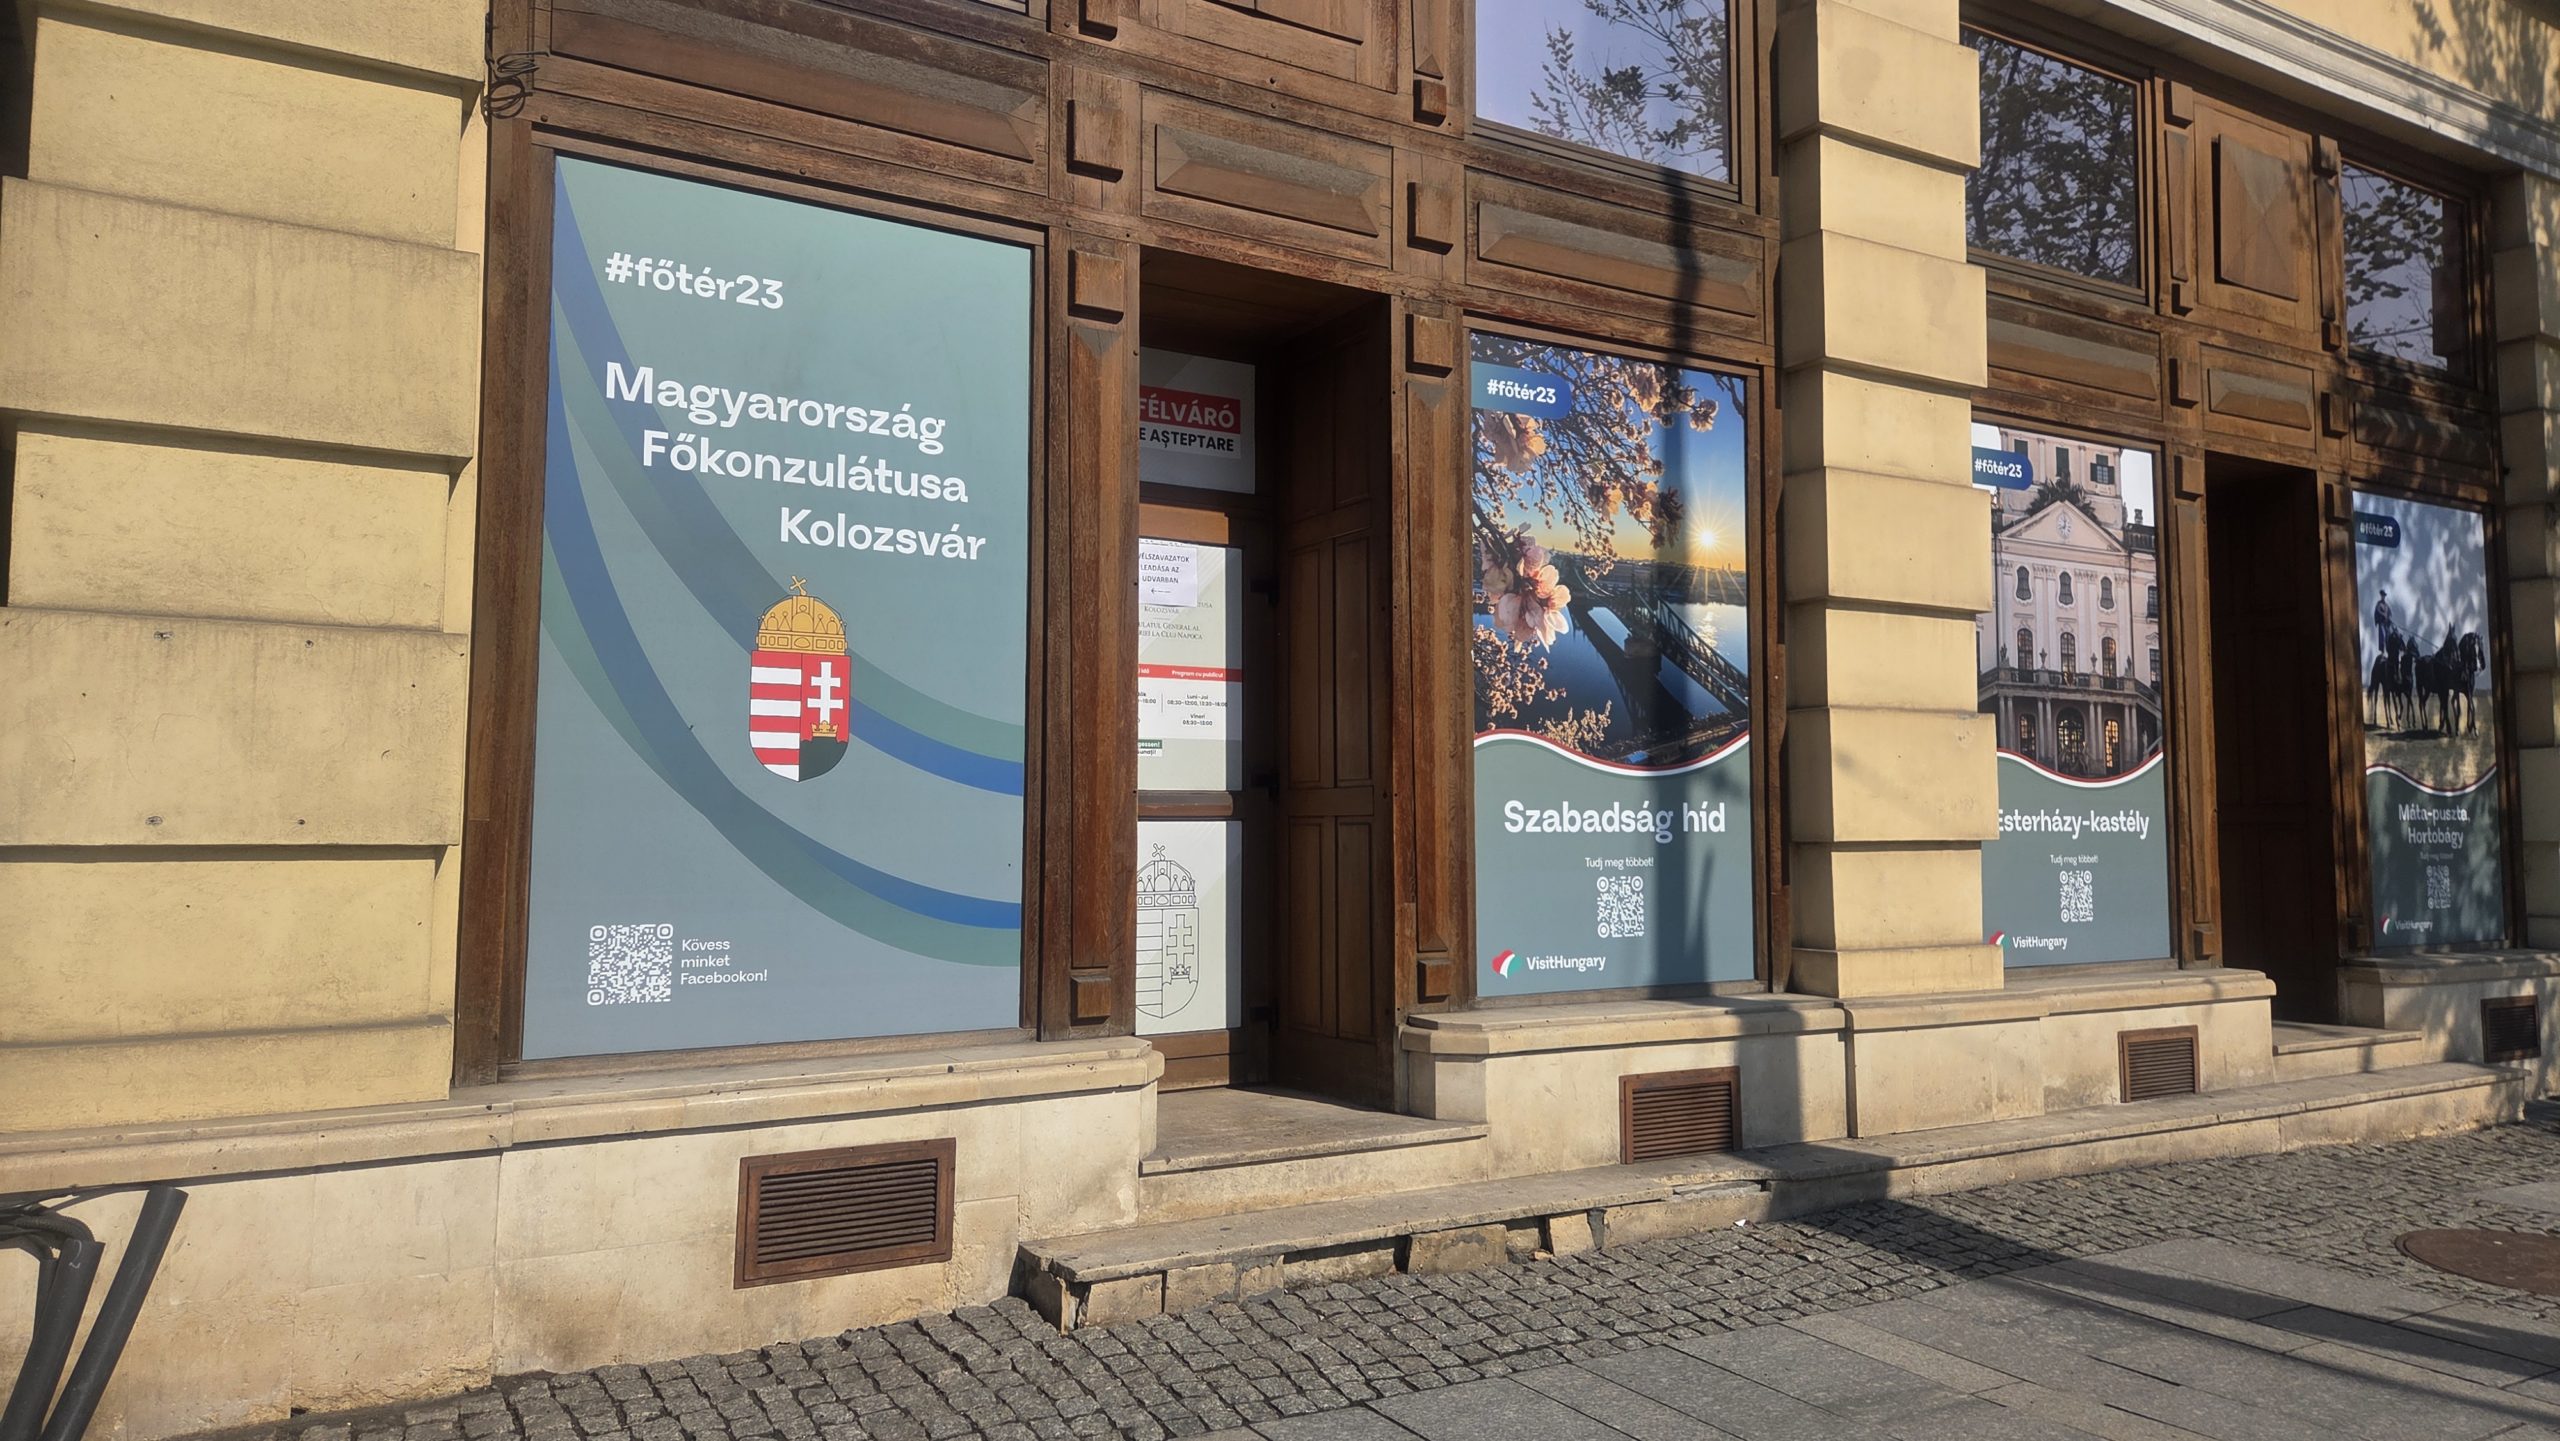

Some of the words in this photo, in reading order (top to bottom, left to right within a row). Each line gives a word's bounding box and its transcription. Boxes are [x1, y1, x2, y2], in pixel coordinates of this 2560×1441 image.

[605, 252, 784, 309] #főtér23
[1487, 379, 1556, 404] #főtér23
[605, 361, 946, 455] Magyarország
[643, 430, 968, 503] Főkonzulátusa
[1974, 458, 2023, 478] #főtér23
[780, 507, 986, 560] Kolozsvár
[1142, 575, 1179, 583] UDVARBAN
[1504, 800, 1673, 844] Szabadság
[1683, 801, 1726, 832] híd
[2408, 827, 2464, 849] Hortobágy
[1585, 857, 1603, 870] Tudj
[1605, 860, 1624, 870] meg
[1625, 857, 1654, 868] többet!
[2050, 855, 2063, 866] Tudj
[2064, 857, 2077, 866] meg
[682, 938, 730, 951] Kövess
[2012, 936, 2068, 950] VisitHungary
[681, 954, 730, 968] minket
[1526, 955, 1606, 972] VisitHungary
[680, 969, 768, 985] Facebookon!
